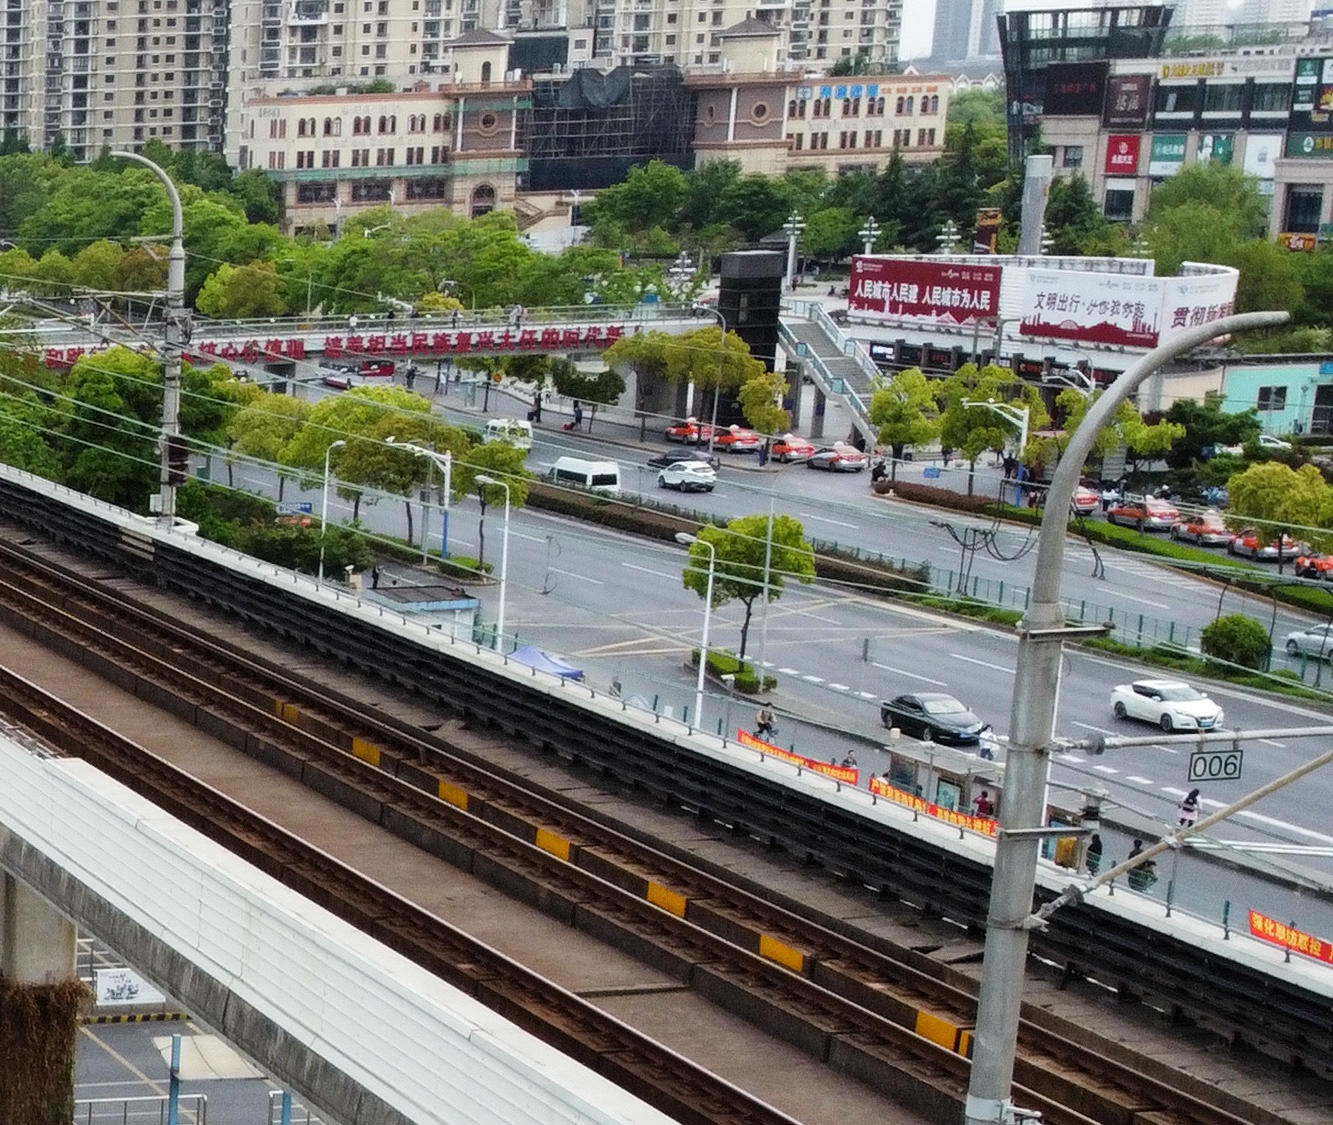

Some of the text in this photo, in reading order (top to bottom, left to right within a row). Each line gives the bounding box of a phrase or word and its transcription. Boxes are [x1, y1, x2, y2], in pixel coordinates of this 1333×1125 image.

[854, 280, 990, 311] 人民城市人民建 人民城市为人民
[324, 325, 641, 358] 培养担当民族复兴大任的时代新
[1193, 754, 1238, 778] 006
